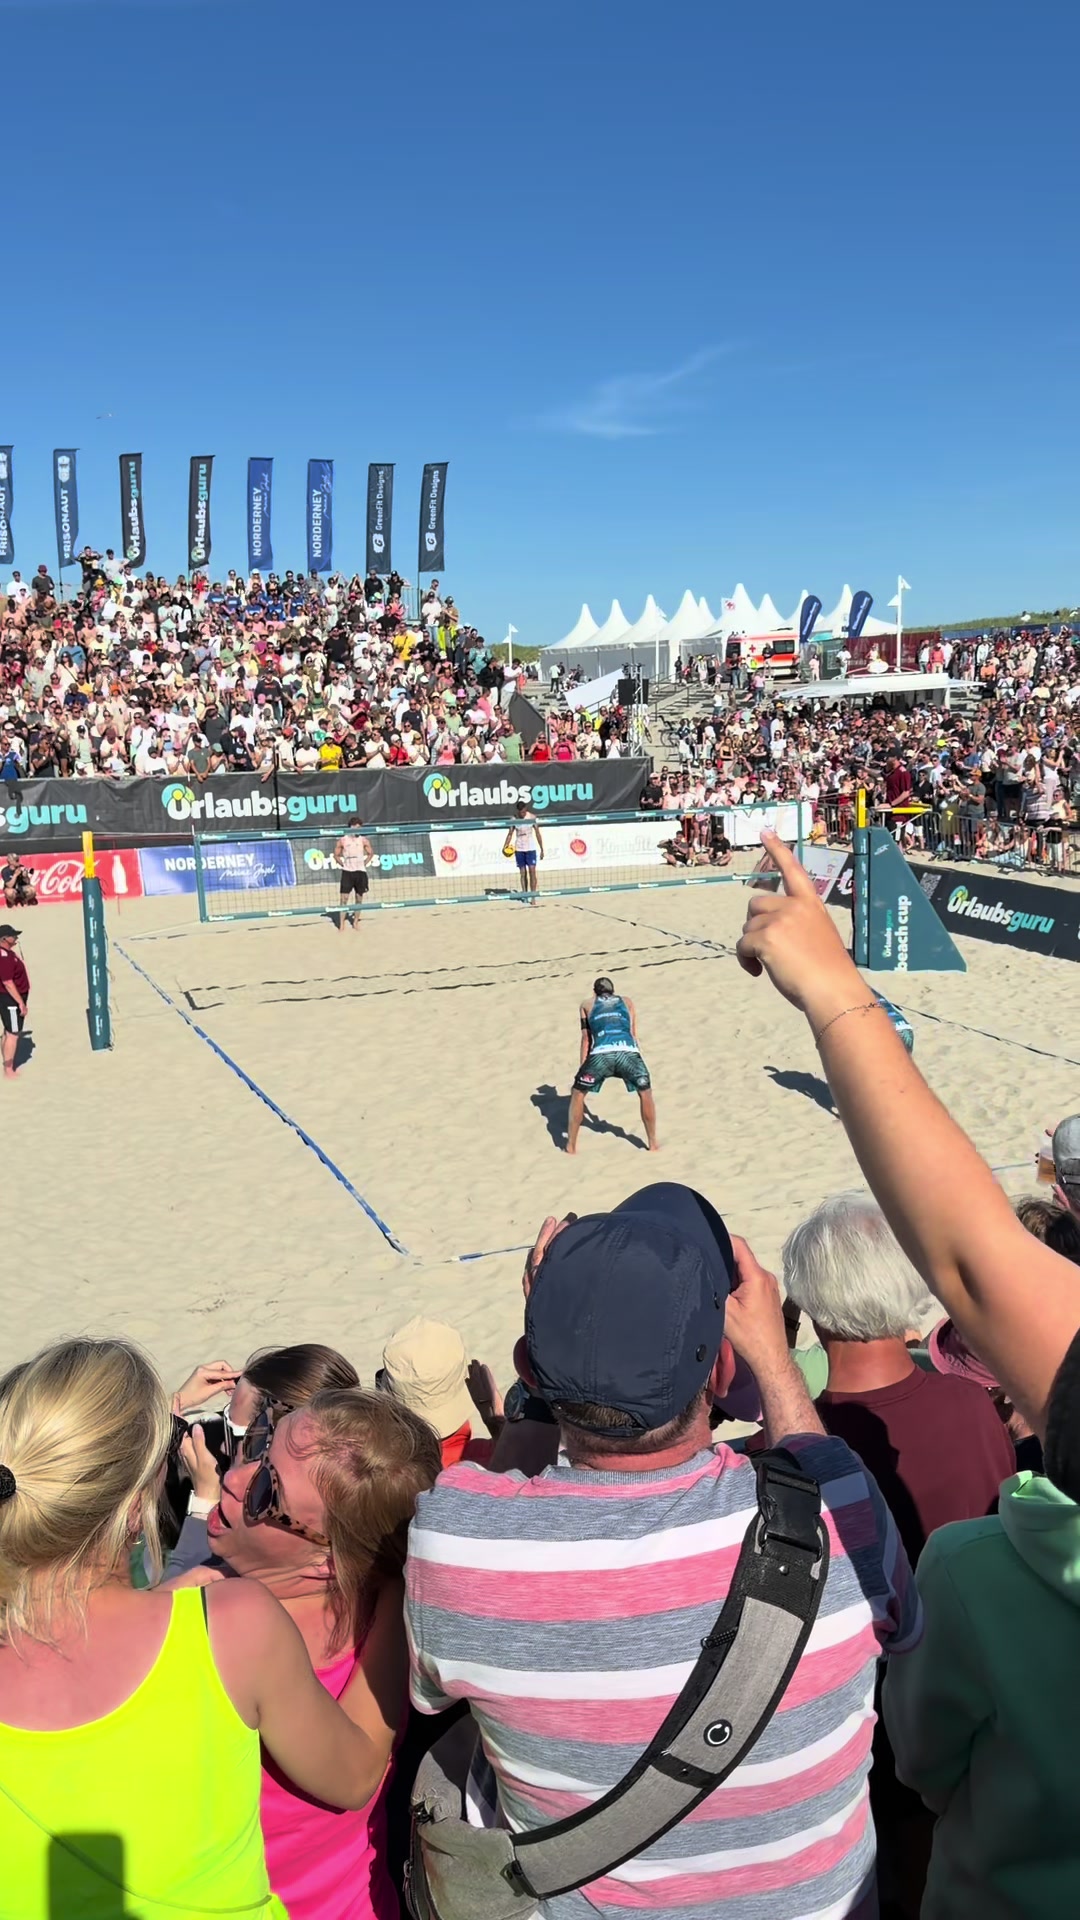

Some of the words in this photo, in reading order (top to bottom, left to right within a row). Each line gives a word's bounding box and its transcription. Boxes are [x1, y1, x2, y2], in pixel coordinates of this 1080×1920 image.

[191, 464, 208, 561] Urlaubsguru
[252, 487, 262, 557] NORDERNEY
[312, 489, 322, 558] NORDERNEY
[162, 784, 357, 821] Urlaubsguru
[423, 773, 593, 809] Urlaubsguru
[898, 895, 912, 924] cup
[947, 886, 1055, 933] Urlaubsguru
[894, 926, 909, 971] beach
